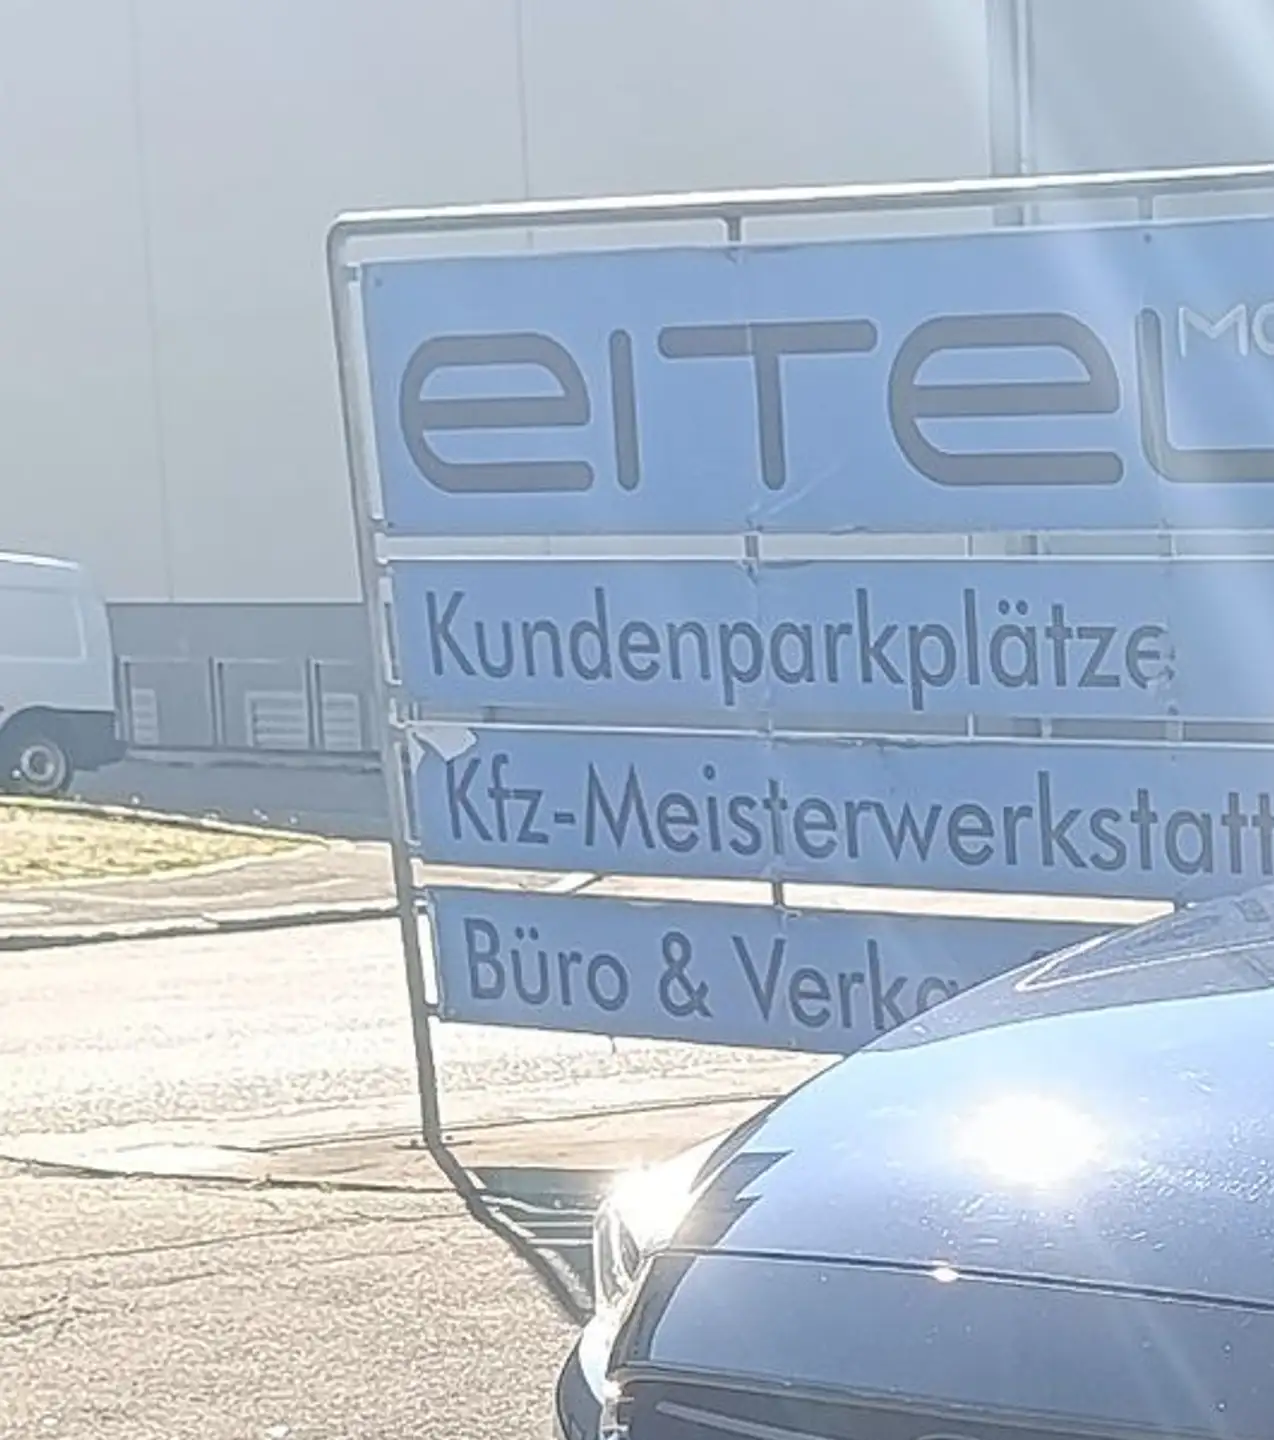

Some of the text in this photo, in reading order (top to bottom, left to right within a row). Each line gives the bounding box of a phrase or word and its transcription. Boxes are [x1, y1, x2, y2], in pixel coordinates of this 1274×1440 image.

[425, 586, 1176, 711] Kundenparkplätze
[463, 916, 629, 1012] Büro
[660, 930, 710, 1020] &
